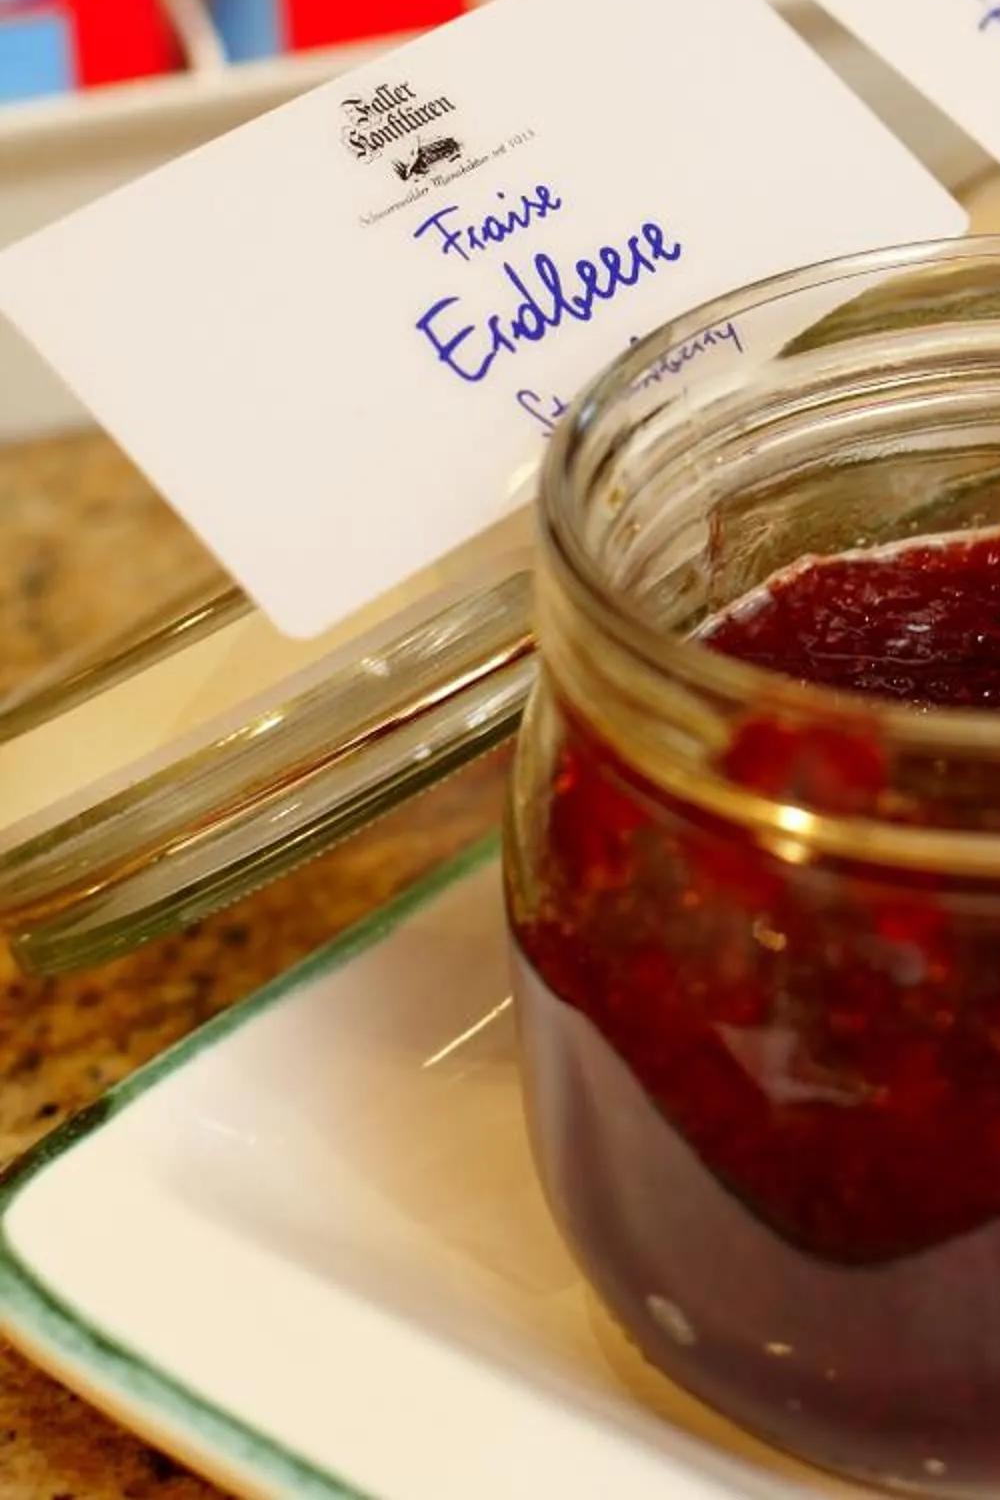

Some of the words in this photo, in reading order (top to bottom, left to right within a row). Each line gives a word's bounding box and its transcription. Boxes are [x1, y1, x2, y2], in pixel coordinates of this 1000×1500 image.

[340, 80, 417, 123] Faller
[412, 185, 562, 261] Fraise
[415, 222, 682, 382] Erdbeere
